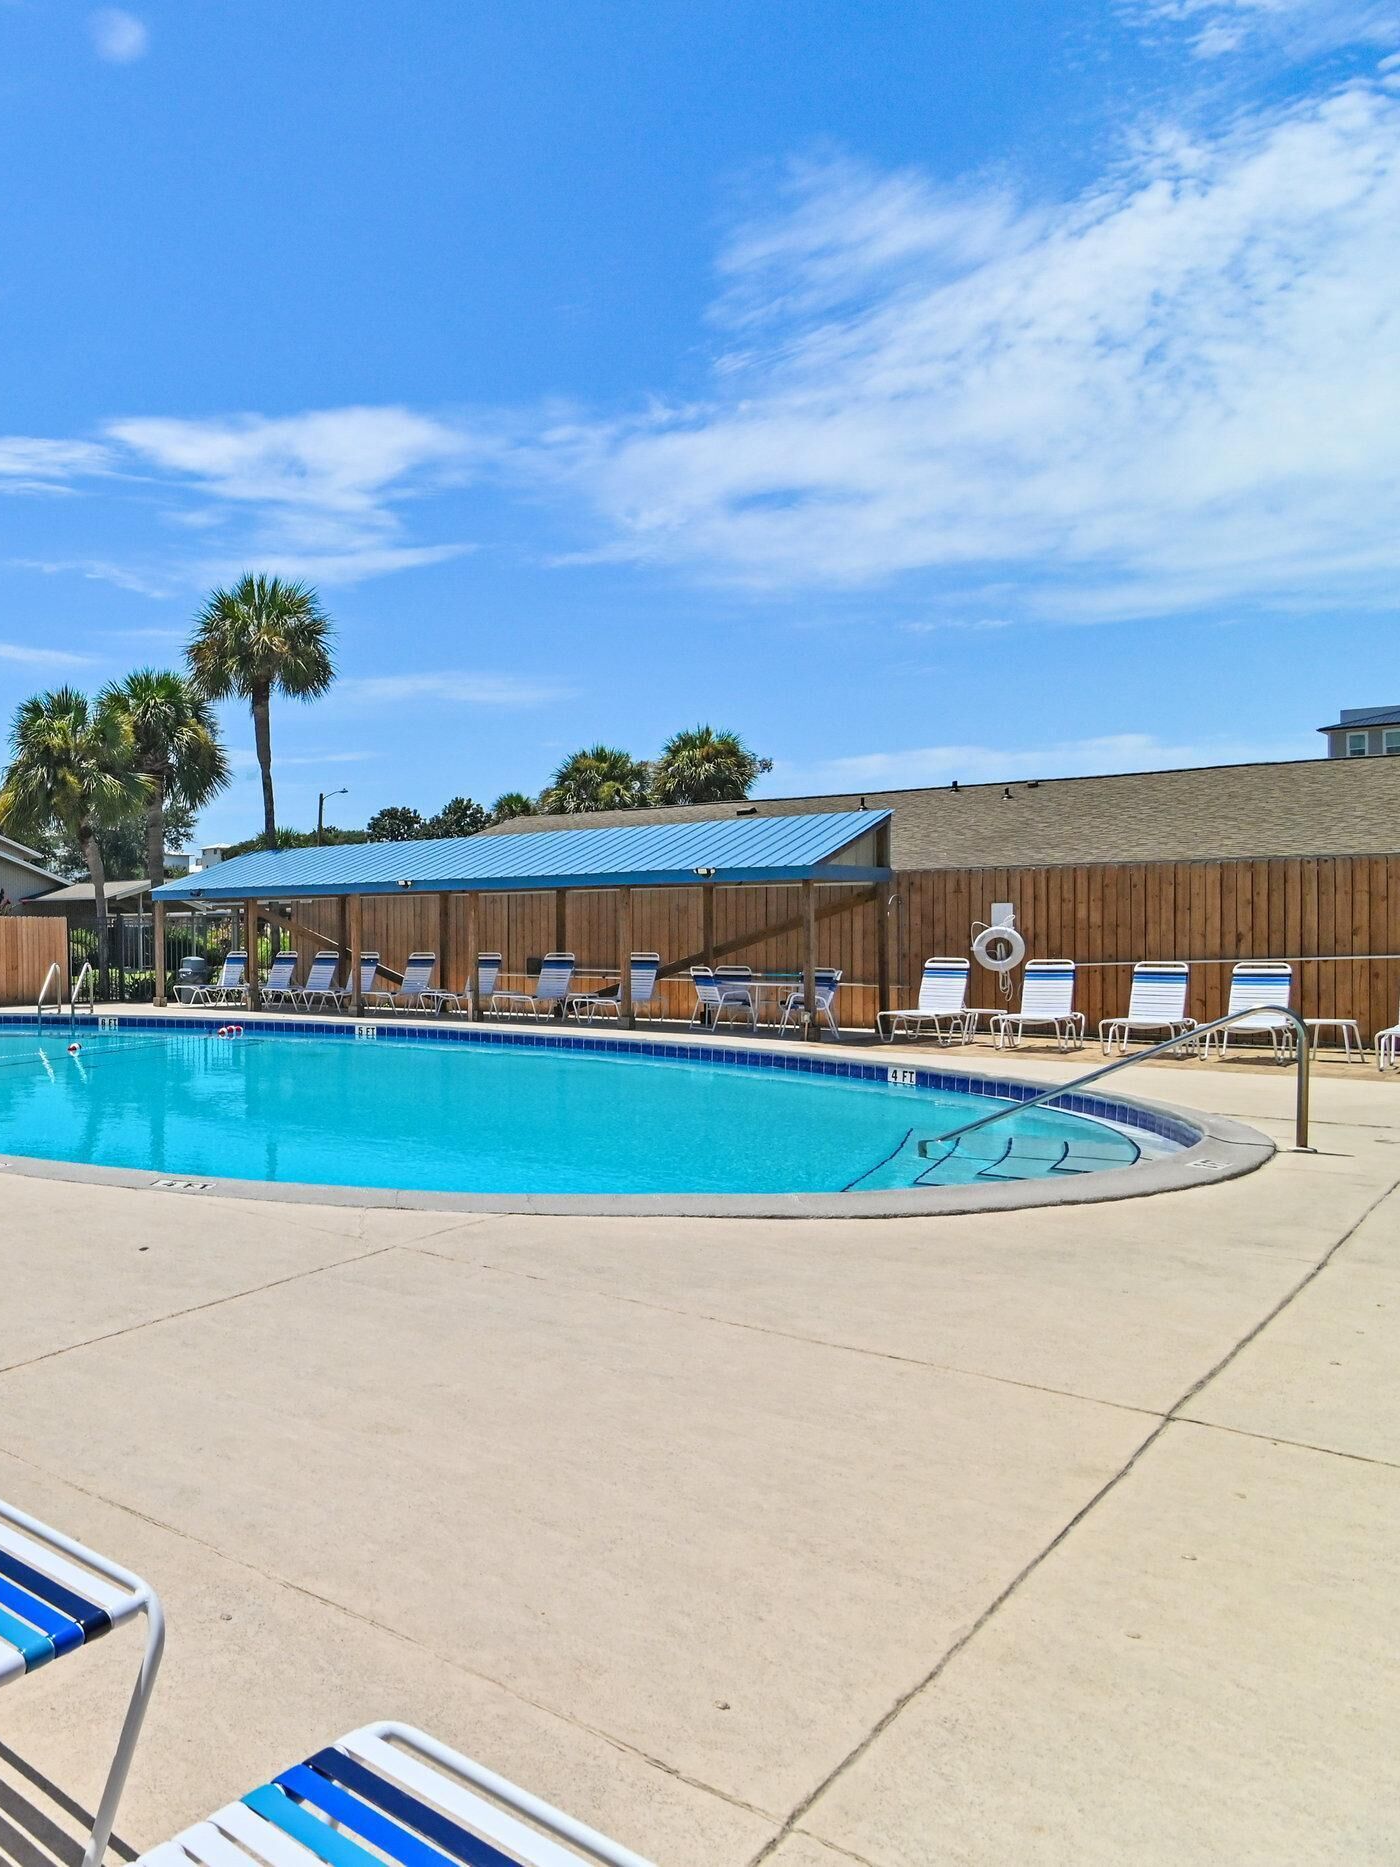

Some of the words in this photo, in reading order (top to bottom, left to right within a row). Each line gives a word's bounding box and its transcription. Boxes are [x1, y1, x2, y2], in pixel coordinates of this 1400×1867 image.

[358, 1026, 363, 1036] 5
[366, 1027, 376, 1036] FT
[891, 1069, 898, 1081] 4
